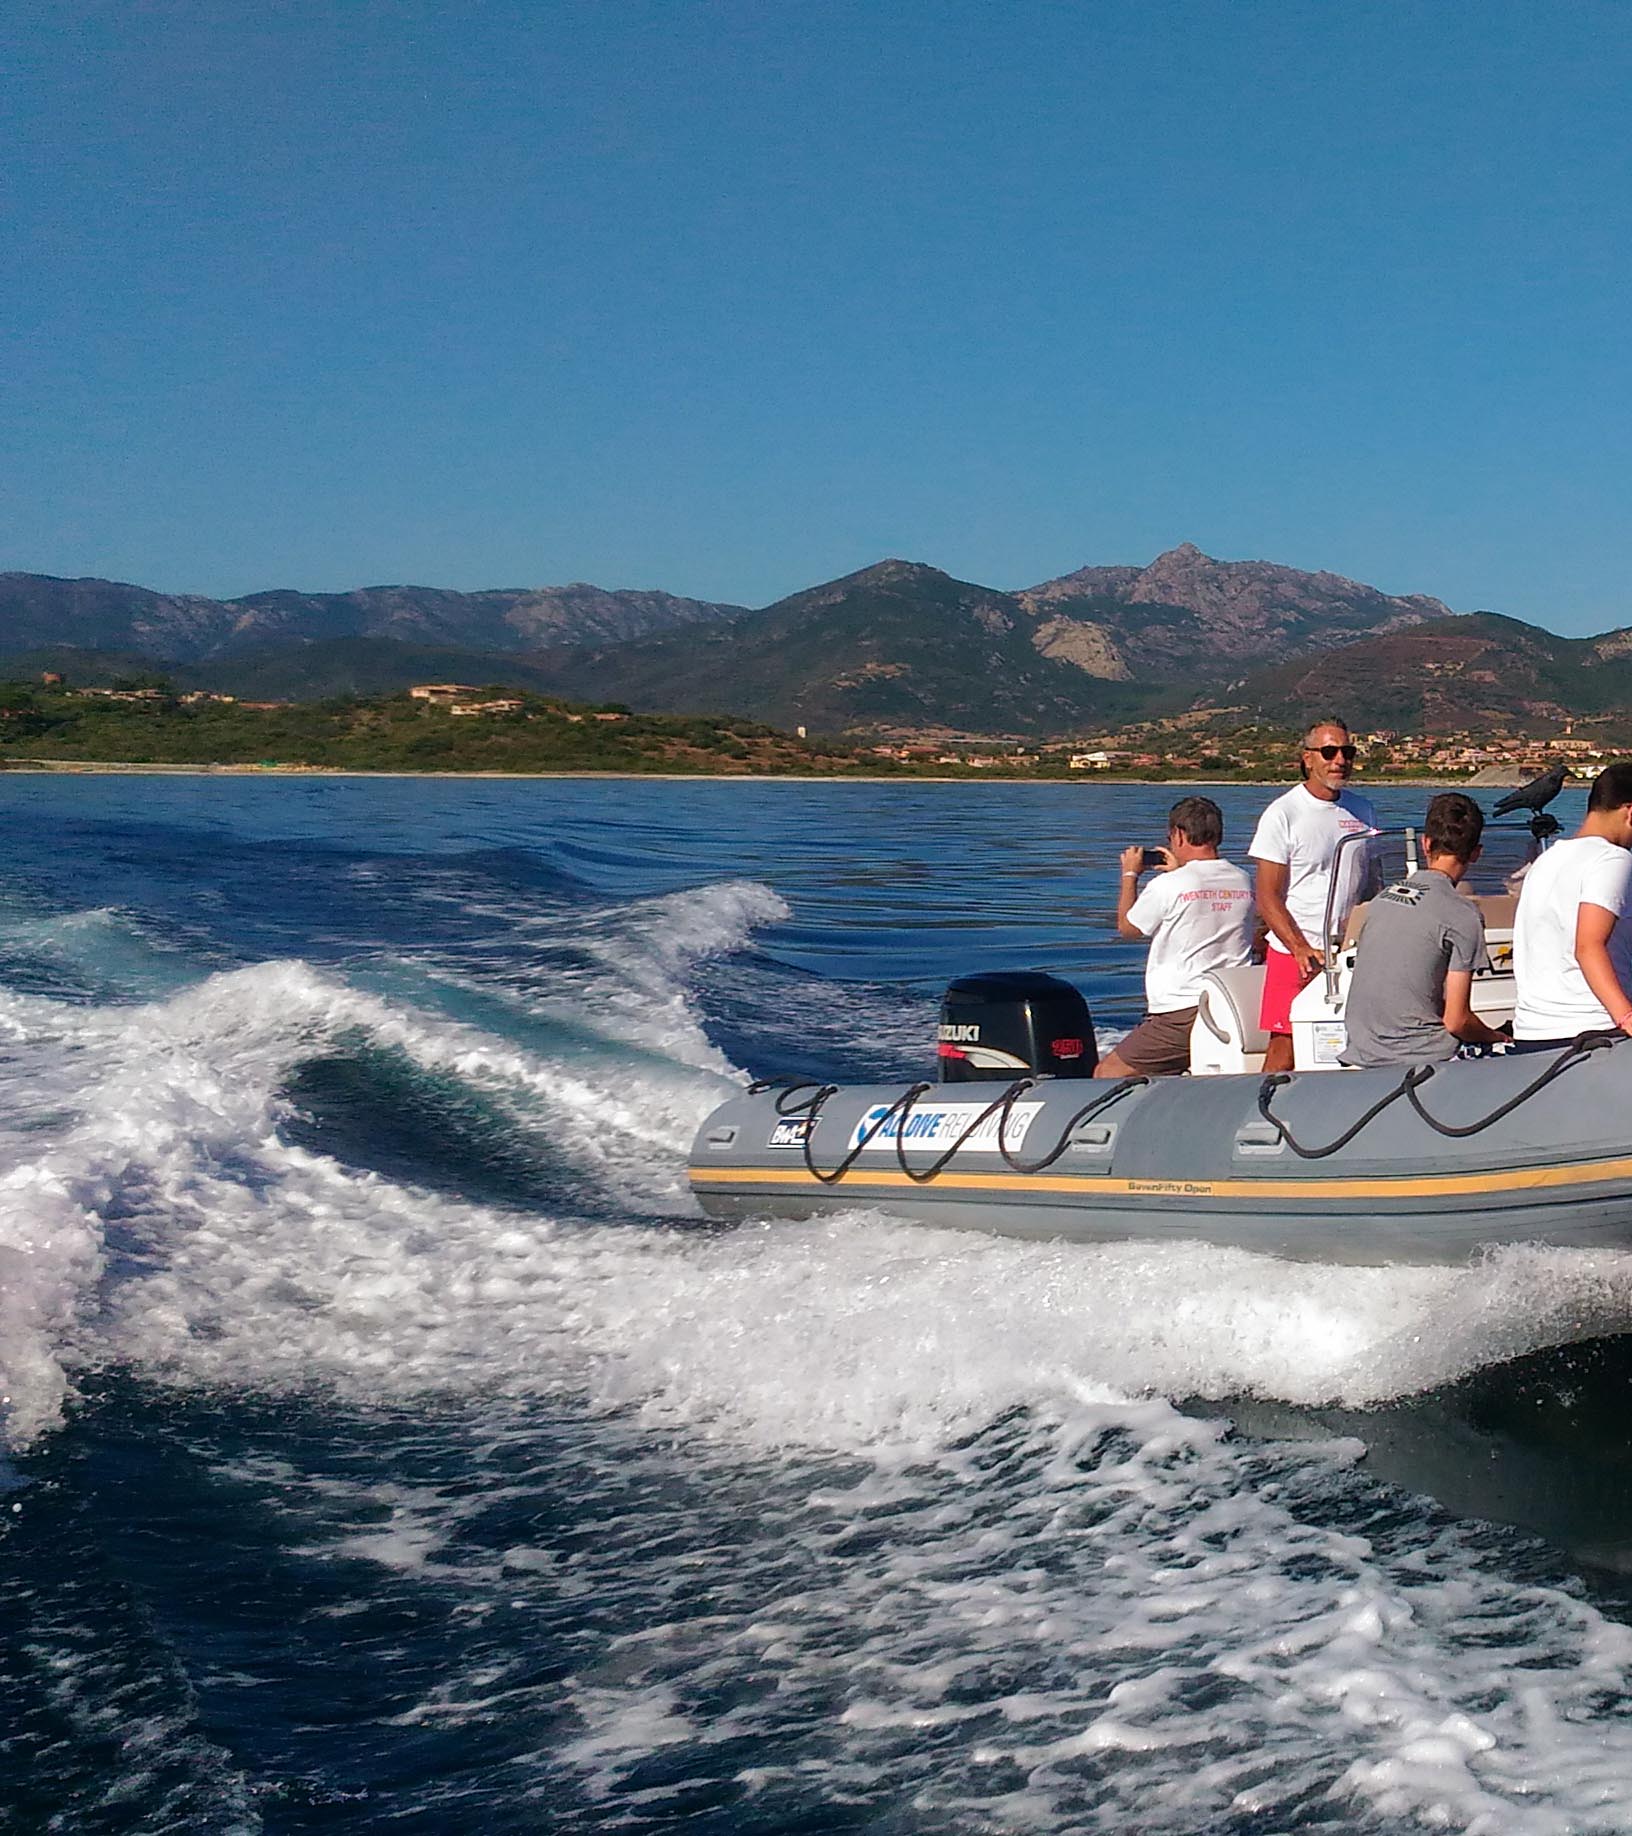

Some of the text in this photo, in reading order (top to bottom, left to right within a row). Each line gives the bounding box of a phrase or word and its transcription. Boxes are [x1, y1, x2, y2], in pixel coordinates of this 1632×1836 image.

[1218, 890, 1249, 900] CENTURY
[1211, 902, 1233, 912] STAFF
[1184, 1183, 1211, 1194] Open
